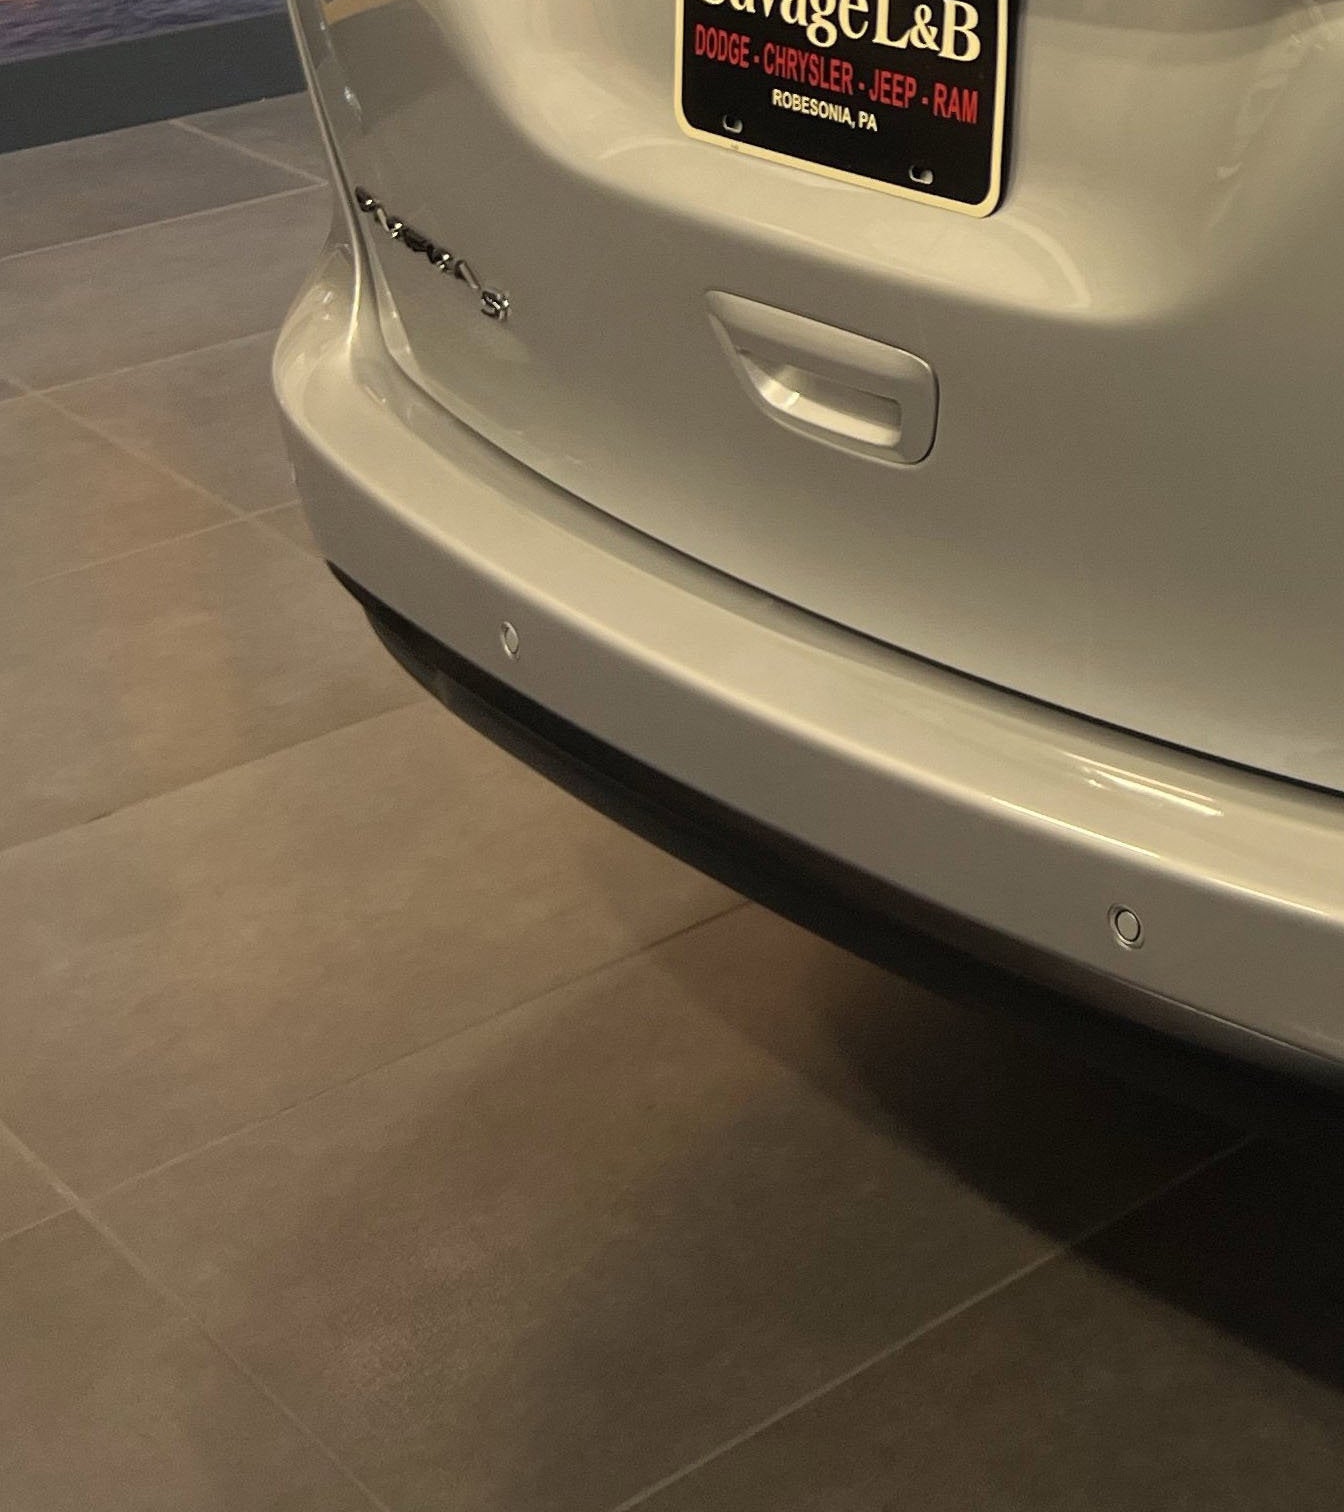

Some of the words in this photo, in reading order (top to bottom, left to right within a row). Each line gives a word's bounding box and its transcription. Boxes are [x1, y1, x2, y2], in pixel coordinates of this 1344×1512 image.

[694, 24, 750, 69] DODGE
[762, 41, 854, 96] CHRYSLER
[868, 68, 917, 110] JEEP
[932, 82, 979, 125] RAM
[771, 88, 856, 129] ROBESONIA,
[857, 111, 878, 132] PA
